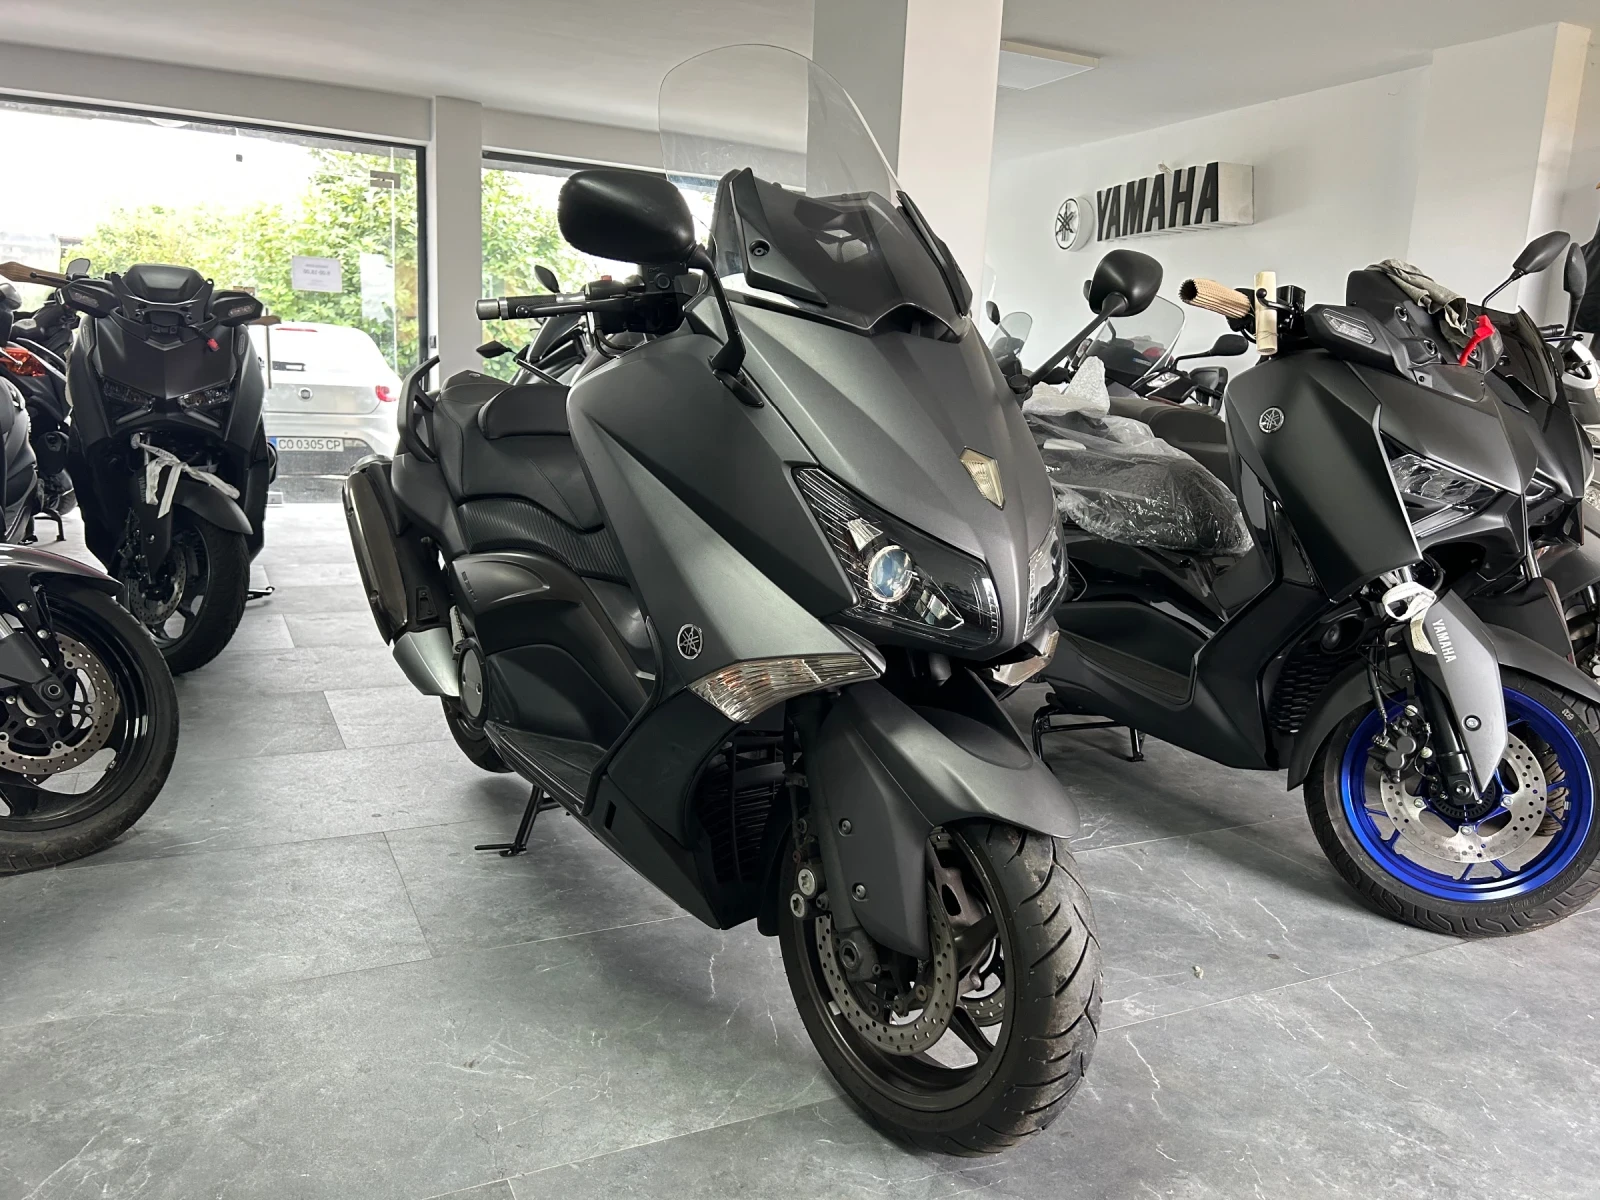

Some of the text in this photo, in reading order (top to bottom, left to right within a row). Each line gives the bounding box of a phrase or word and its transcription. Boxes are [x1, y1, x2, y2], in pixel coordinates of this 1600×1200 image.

[1096, 161, 1219, 242] YAMAHA
[278, 439, 341, 450] CO 0305 CP
[1432, 618, 1457, 663] YAMAHA
